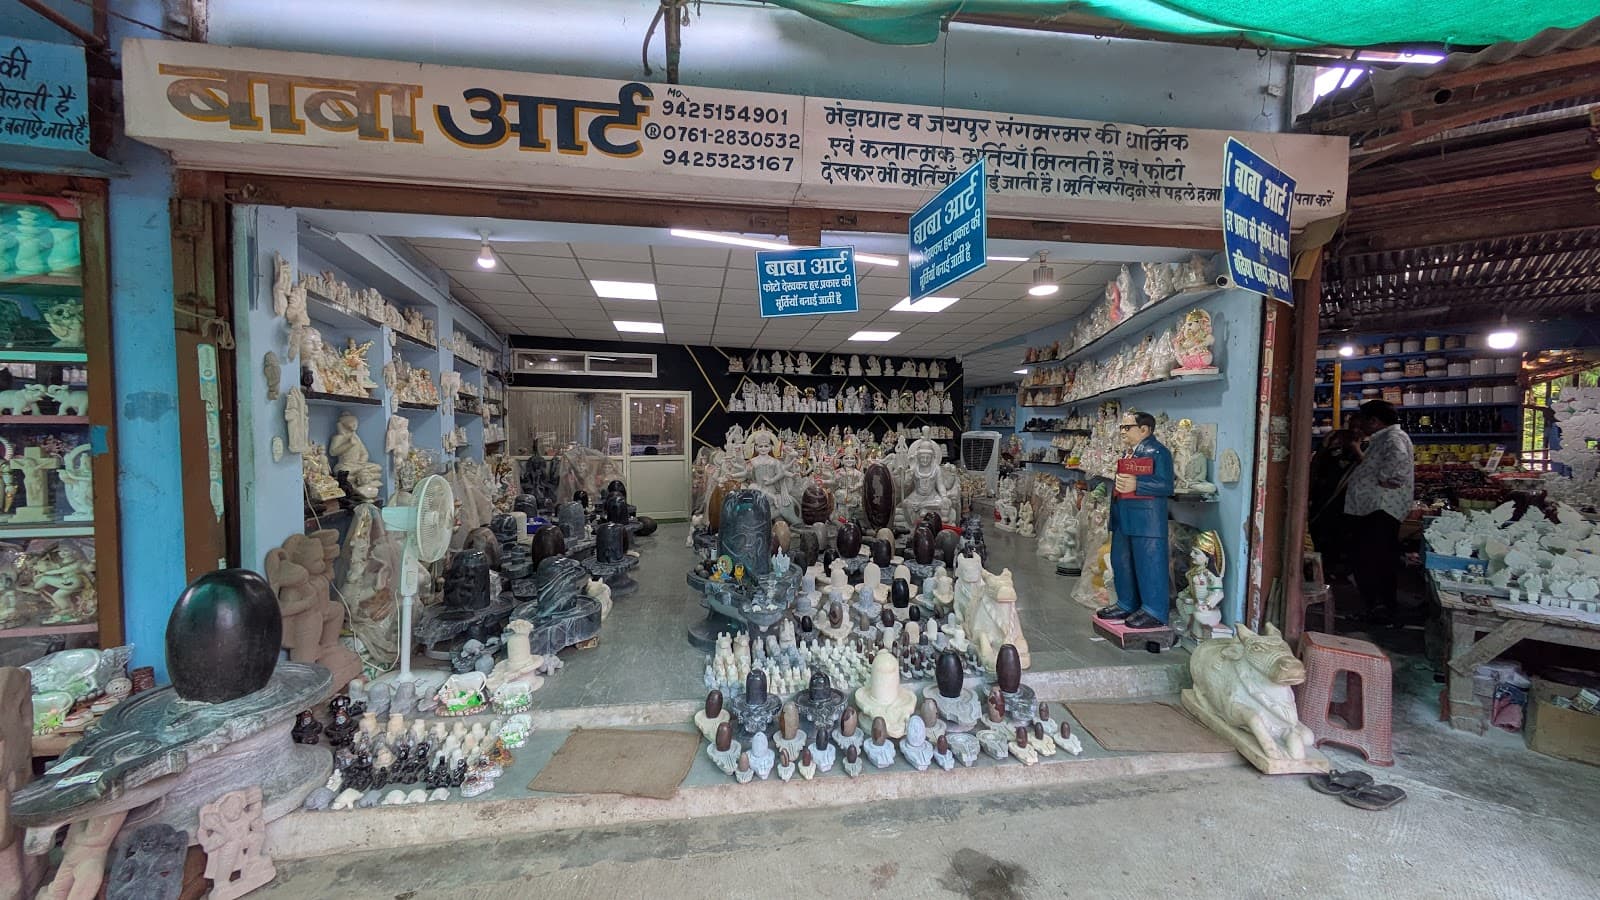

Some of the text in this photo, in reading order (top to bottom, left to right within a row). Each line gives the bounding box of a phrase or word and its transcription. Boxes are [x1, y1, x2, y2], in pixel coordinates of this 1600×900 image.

[0, 46, 32, 80] की
[158, 63, 654, 159] बाबा आर्ट
[662, 100, 789, 125] 9425154901
[907, 113, 923, 130] व
[926, 114, 991, 142] जयपुर
[995, 116, 1091, 144] संगमरमर
[1094, 123, 1121, 146] की
[1126, 128, 1189, 152] धार्मिक
[662, 149, 795, 173] 9425323167
[828, 135, 855, 157] एवं
[860, 139, 955, 164] कलात्मक
[1031, 146, 1100, 174] मिलती
[1117, 158, 1139, 178] एवं
[1142, 157, 1186, 182] फोटो
[820, 155, 875, 184] देखकर
[877, 161, 902, 184] भी
[1002, 171, 1038, 191] जाती
[1063, 174, 1097, 197] मूर्ति
[1148, 180, 1162, 199] से
[1163, 182, 1197, 202] पहले
[1234, 159, 1288, 217] बाबा आर्ट
[913, 169, 979, 245] बाबा आर्ट
[943, 233, 954, 252] हर
[953, 221, 970, 244] प्रकार
[970, 207, 981, 230] की
[764, 250, 849, 276] बाबा आर्ट
[935, 252, 951, 277] बनाई
[950, 244, 965, 269] जाती
[762, 274, 852, 293] फोटो देखकर हर प्रकार की
[799, 293, 818, 307] बनाई
[818, 291, 835, 305] जाती
